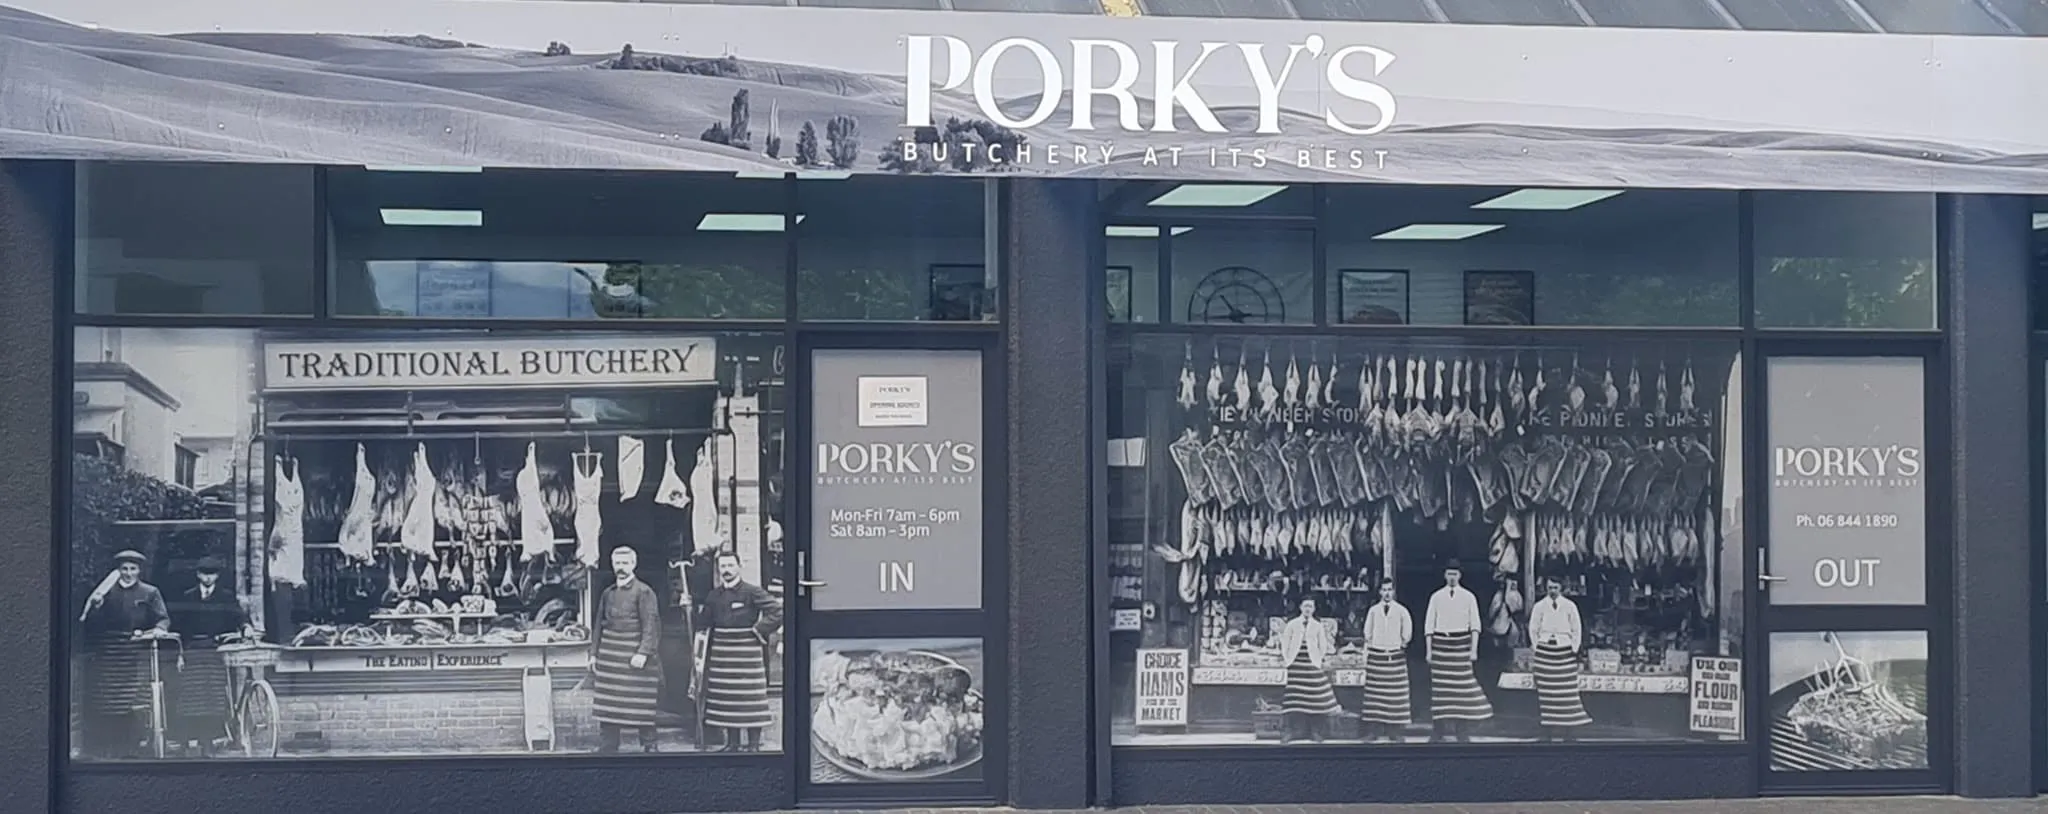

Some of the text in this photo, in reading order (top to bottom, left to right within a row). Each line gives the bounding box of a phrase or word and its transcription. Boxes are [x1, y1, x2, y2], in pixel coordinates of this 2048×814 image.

[904, 34, 1398, 135] PORKY'S
[903, 142, 1389, 169] BUTCHERY AT ITS BEST
[278, 344, 699, 378] TRADITIONAL BUTCHERY
[818, 441, 975, 473] PORKY'S
[1775, 445, 1920, 476] PORKY'S
[831, 508, 882, 522] Mon-Fri
[886, 509, 916, 522] 7am
[929, 508, 960, 524] 6pm
[1796, 514, 1898, 528] Ph. 06 844 1890
[831, 524, 852, 537] Sat
[856, 524, 886, 537] 8am
[899, 524, 930, 540] 3pm
[880, 561, 914, 592] IN
[1814, 559, 1880, 588] OUT
[1140, 671, 1185, 697] HAMS
[1694, 680, 1739, 701] FLOUR
[1141, 707, 1182, 721] MARKET
